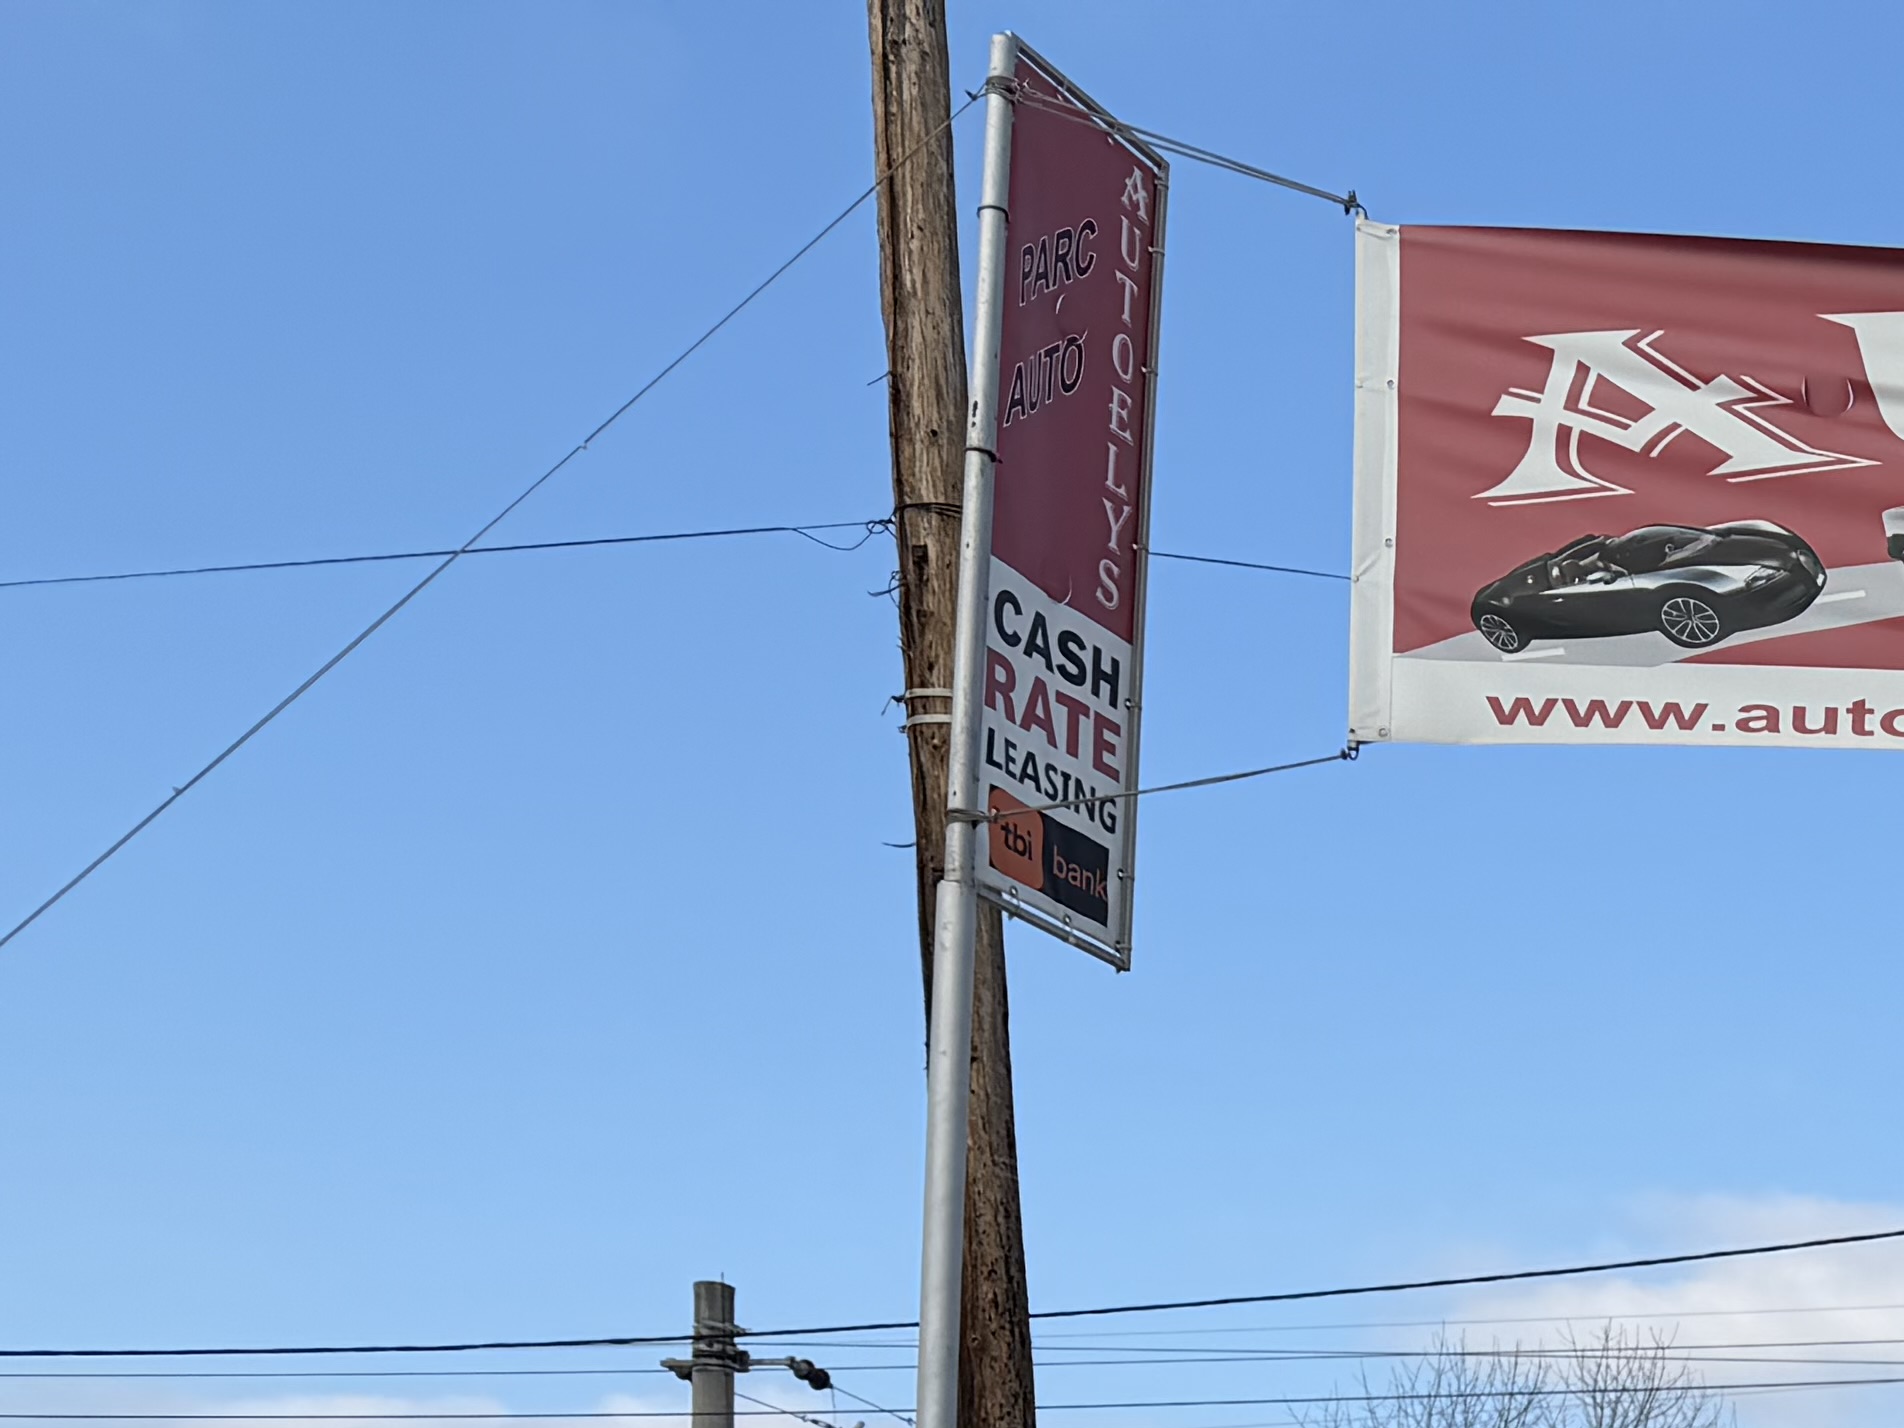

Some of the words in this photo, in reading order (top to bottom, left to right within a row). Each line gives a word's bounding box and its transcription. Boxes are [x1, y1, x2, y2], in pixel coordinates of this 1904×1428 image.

[1019, 218, 1098, 306] PARC
[1003, 332, 1086, 428] AUTO
[1096, 165, 1150, 610] AUTOELYS
[993, 589, 1121, 710] CASH
[984, 645, 1122, 784] RATE
[985, 726, 1118, 835] LEASING
[1000, 821, 1033, 861] tbi
[1052, 844, 1108, 902] bank
